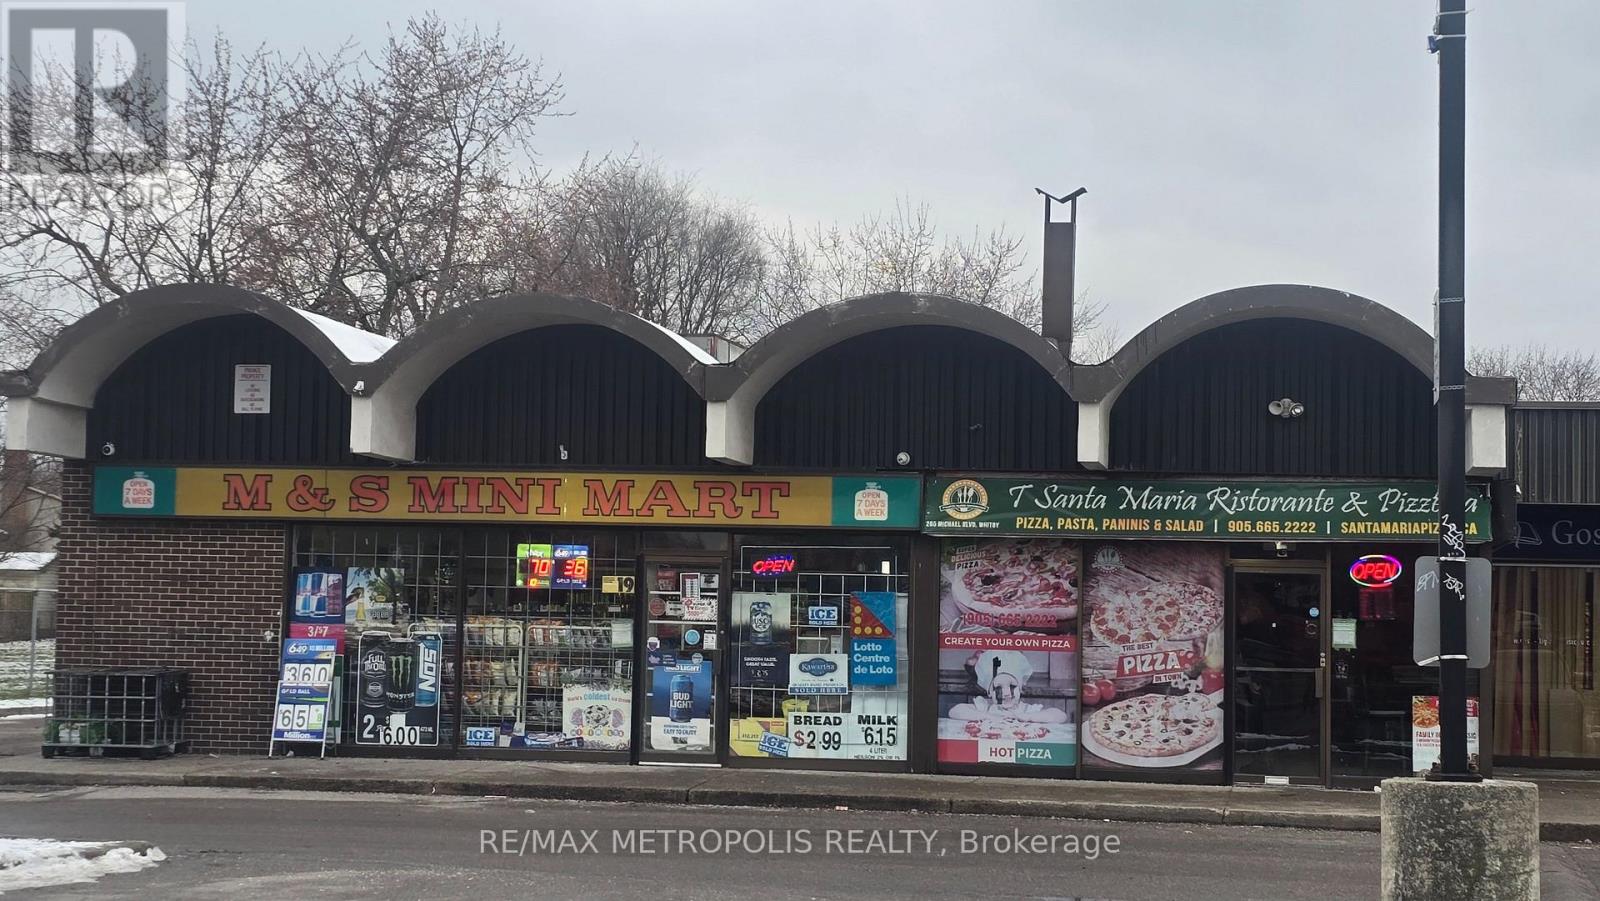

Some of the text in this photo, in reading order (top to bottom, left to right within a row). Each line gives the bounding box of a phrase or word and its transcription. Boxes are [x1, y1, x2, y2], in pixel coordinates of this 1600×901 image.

[133, 488, 152, 496] DAYS
[223, 474, 790, 519] M & S MINI MART
[862, 491, 881, 499] OPEN
[124, 496, 152, 505] A WEEK
[857, 499, 885, 508] 7 DAYS
[1009, 484, 1478, 517] T Santa Maria Ristorante & Pizzea
[856, 508, 885, 517] A WEEK
[1016, 517, 1478, 536] PIZZA, PASTA, PANINIS & SALAD 905.665.2222 SANTAMARIAPIZA
[752, 559, 796, 573] OPEN
[956, 561, 979, 569] PIZZA
[1352, 563, 1397, 580] OPEN
[810, 608, 836, 619] ICE
[854, 642, 882, 652] Lotto
[944, 636, 1071, 649] CREATE YOUR OWN PIZZA
[1122, 642, 1154, 652] THE BEST
[854, 654, 891, 663] Centre
[1123, 652, 1180, 674] PIZZA
[418, 642, 437, 692] NOS
[854, 664, 893, 674] de Loto
[673, 692, 690, 701] BUD
[670, 700, 694, 709] LIGHT
[794, 715, 843, 726] BREAD
[857, 715, 898, 726] MILK
[362, 714, 375, 739] 2
[468, 730, 493, 740] ICE
[794, 730, 841, 751] $2.99
[763, 734, 787, 750] ICE
[989, 747, 1052, 760] HOT PIZZA
